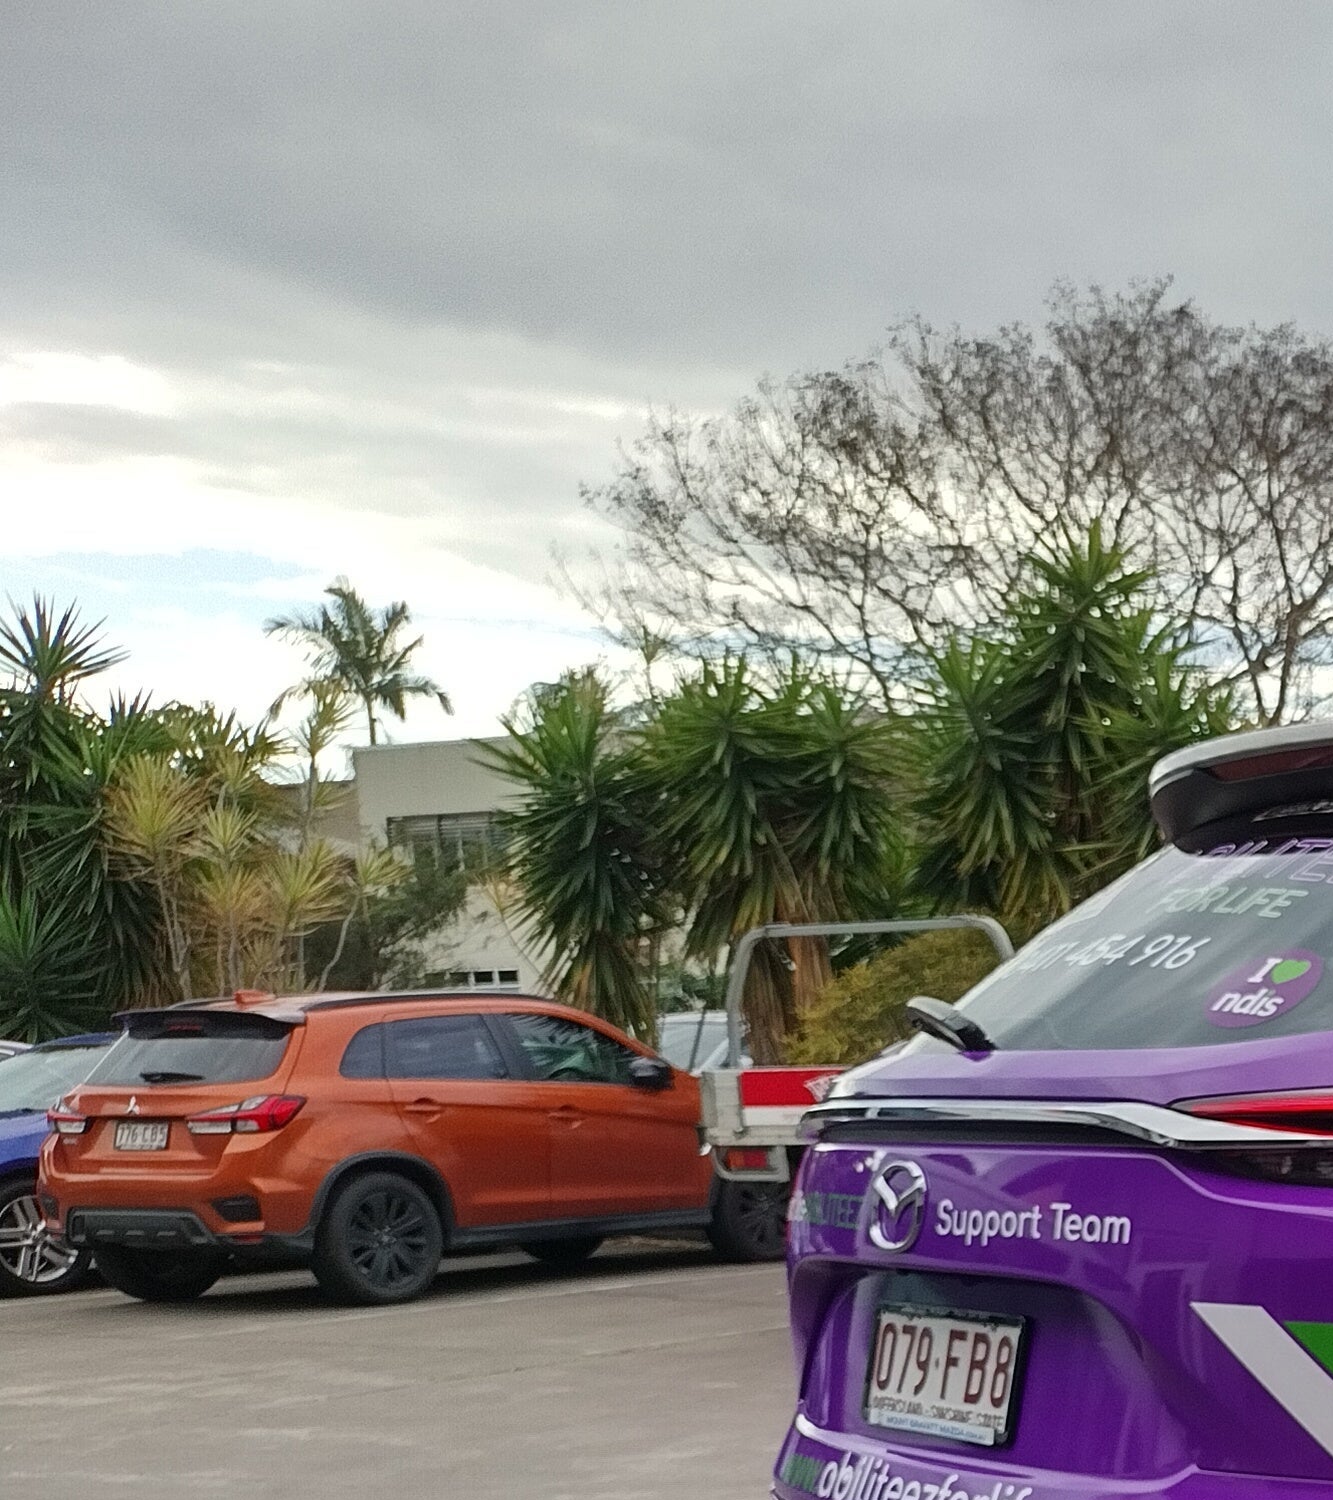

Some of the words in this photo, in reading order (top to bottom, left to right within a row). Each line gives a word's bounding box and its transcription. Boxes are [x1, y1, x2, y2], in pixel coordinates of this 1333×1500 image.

[1212, 887, 1309, 918] LIFE
[1065, 934, 1146, 967] 454
[1129, 934, 1212, 970] 916
[1247, 958, 1283, 983] I
[1210, 988, 1285, 1017] ndis
[935, 1199, 1042, 1247] Support
[1050, 1202, 1132, 1245] Team
